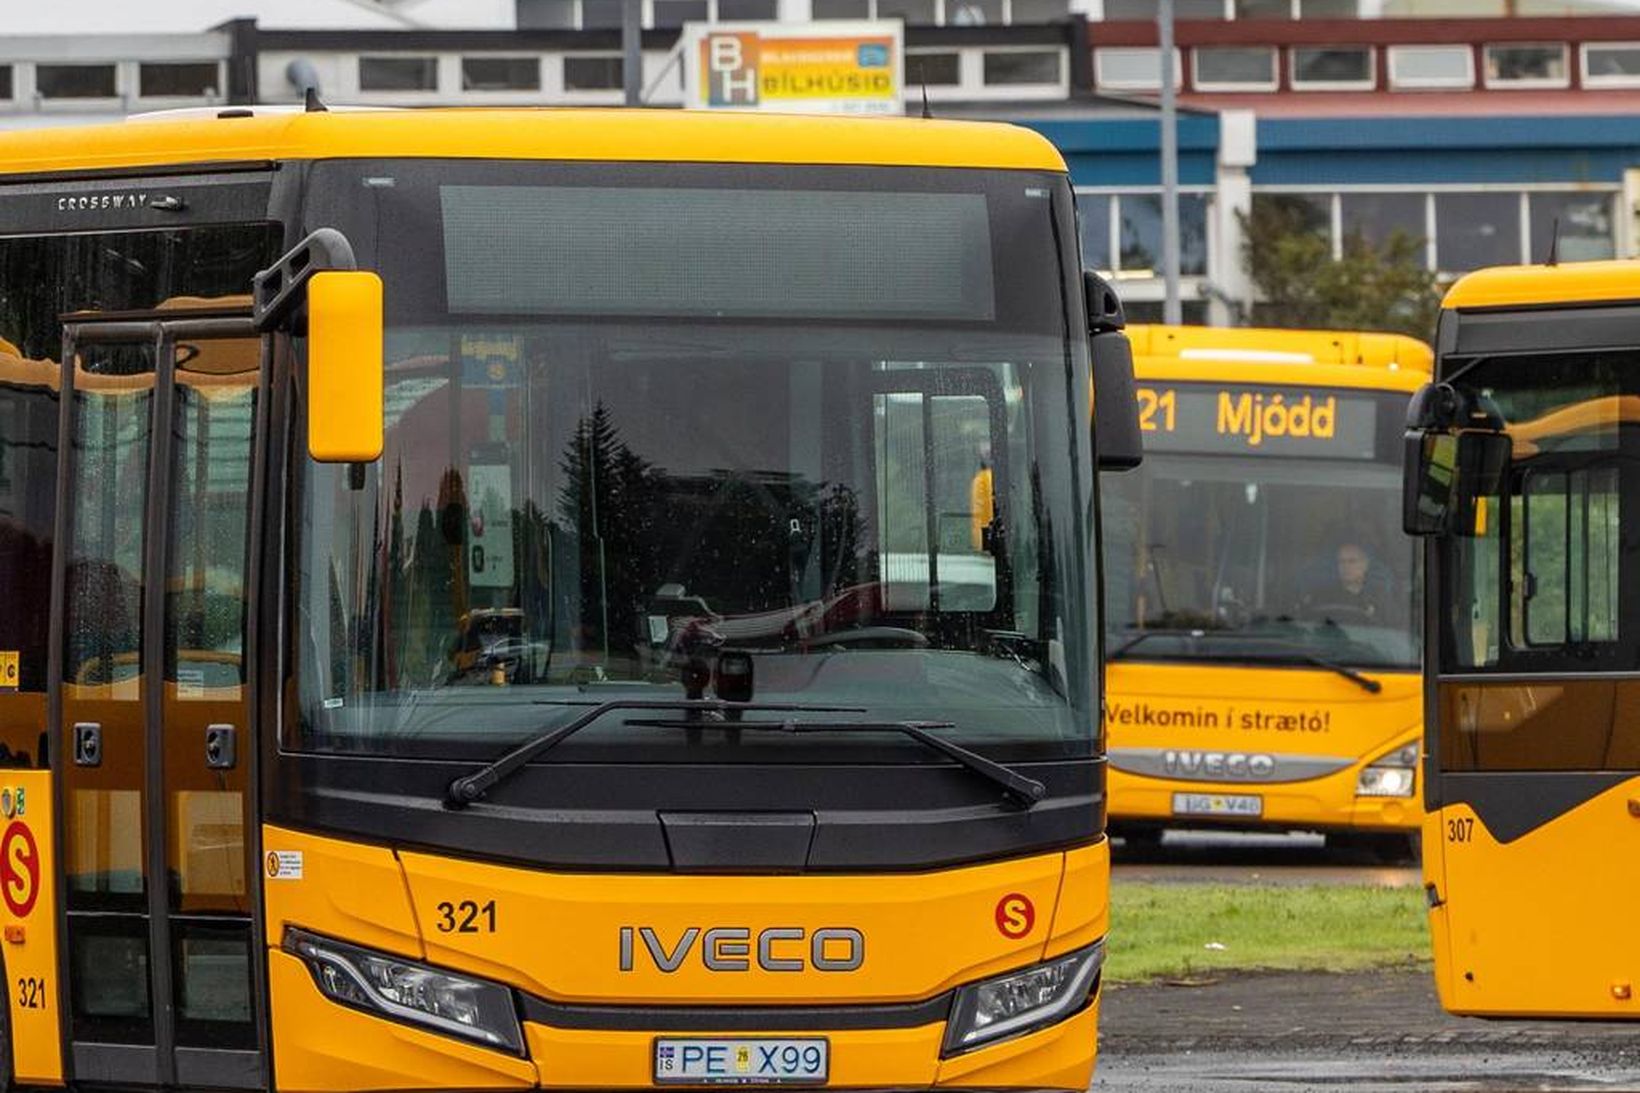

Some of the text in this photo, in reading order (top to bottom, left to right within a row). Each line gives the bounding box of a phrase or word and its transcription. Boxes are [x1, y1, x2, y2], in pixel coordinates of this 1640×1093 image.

[711, 36, 742, 71] B
[723, 68, 755, 102] H
[58, 194, 147, 210] CROSSWAY
[1136, 388, 1336, 445] 21 Mjódd
[1106, 704, 1218, 729] Velkomin
[1241, 710, 1331, 732] strætó!
[1163, 751, 1275, 777] IVECO
[1447, 818, 1474, 842] 307
[8, 834, 32, 905] S
[437, 900, 496, 933] 321
[1003, 899, 1027, 934] S
[619, 927, 865, 973] IVECO
[18, 978, 46, 1010] 321
[682, 1046, 821, 1073] PE X99
